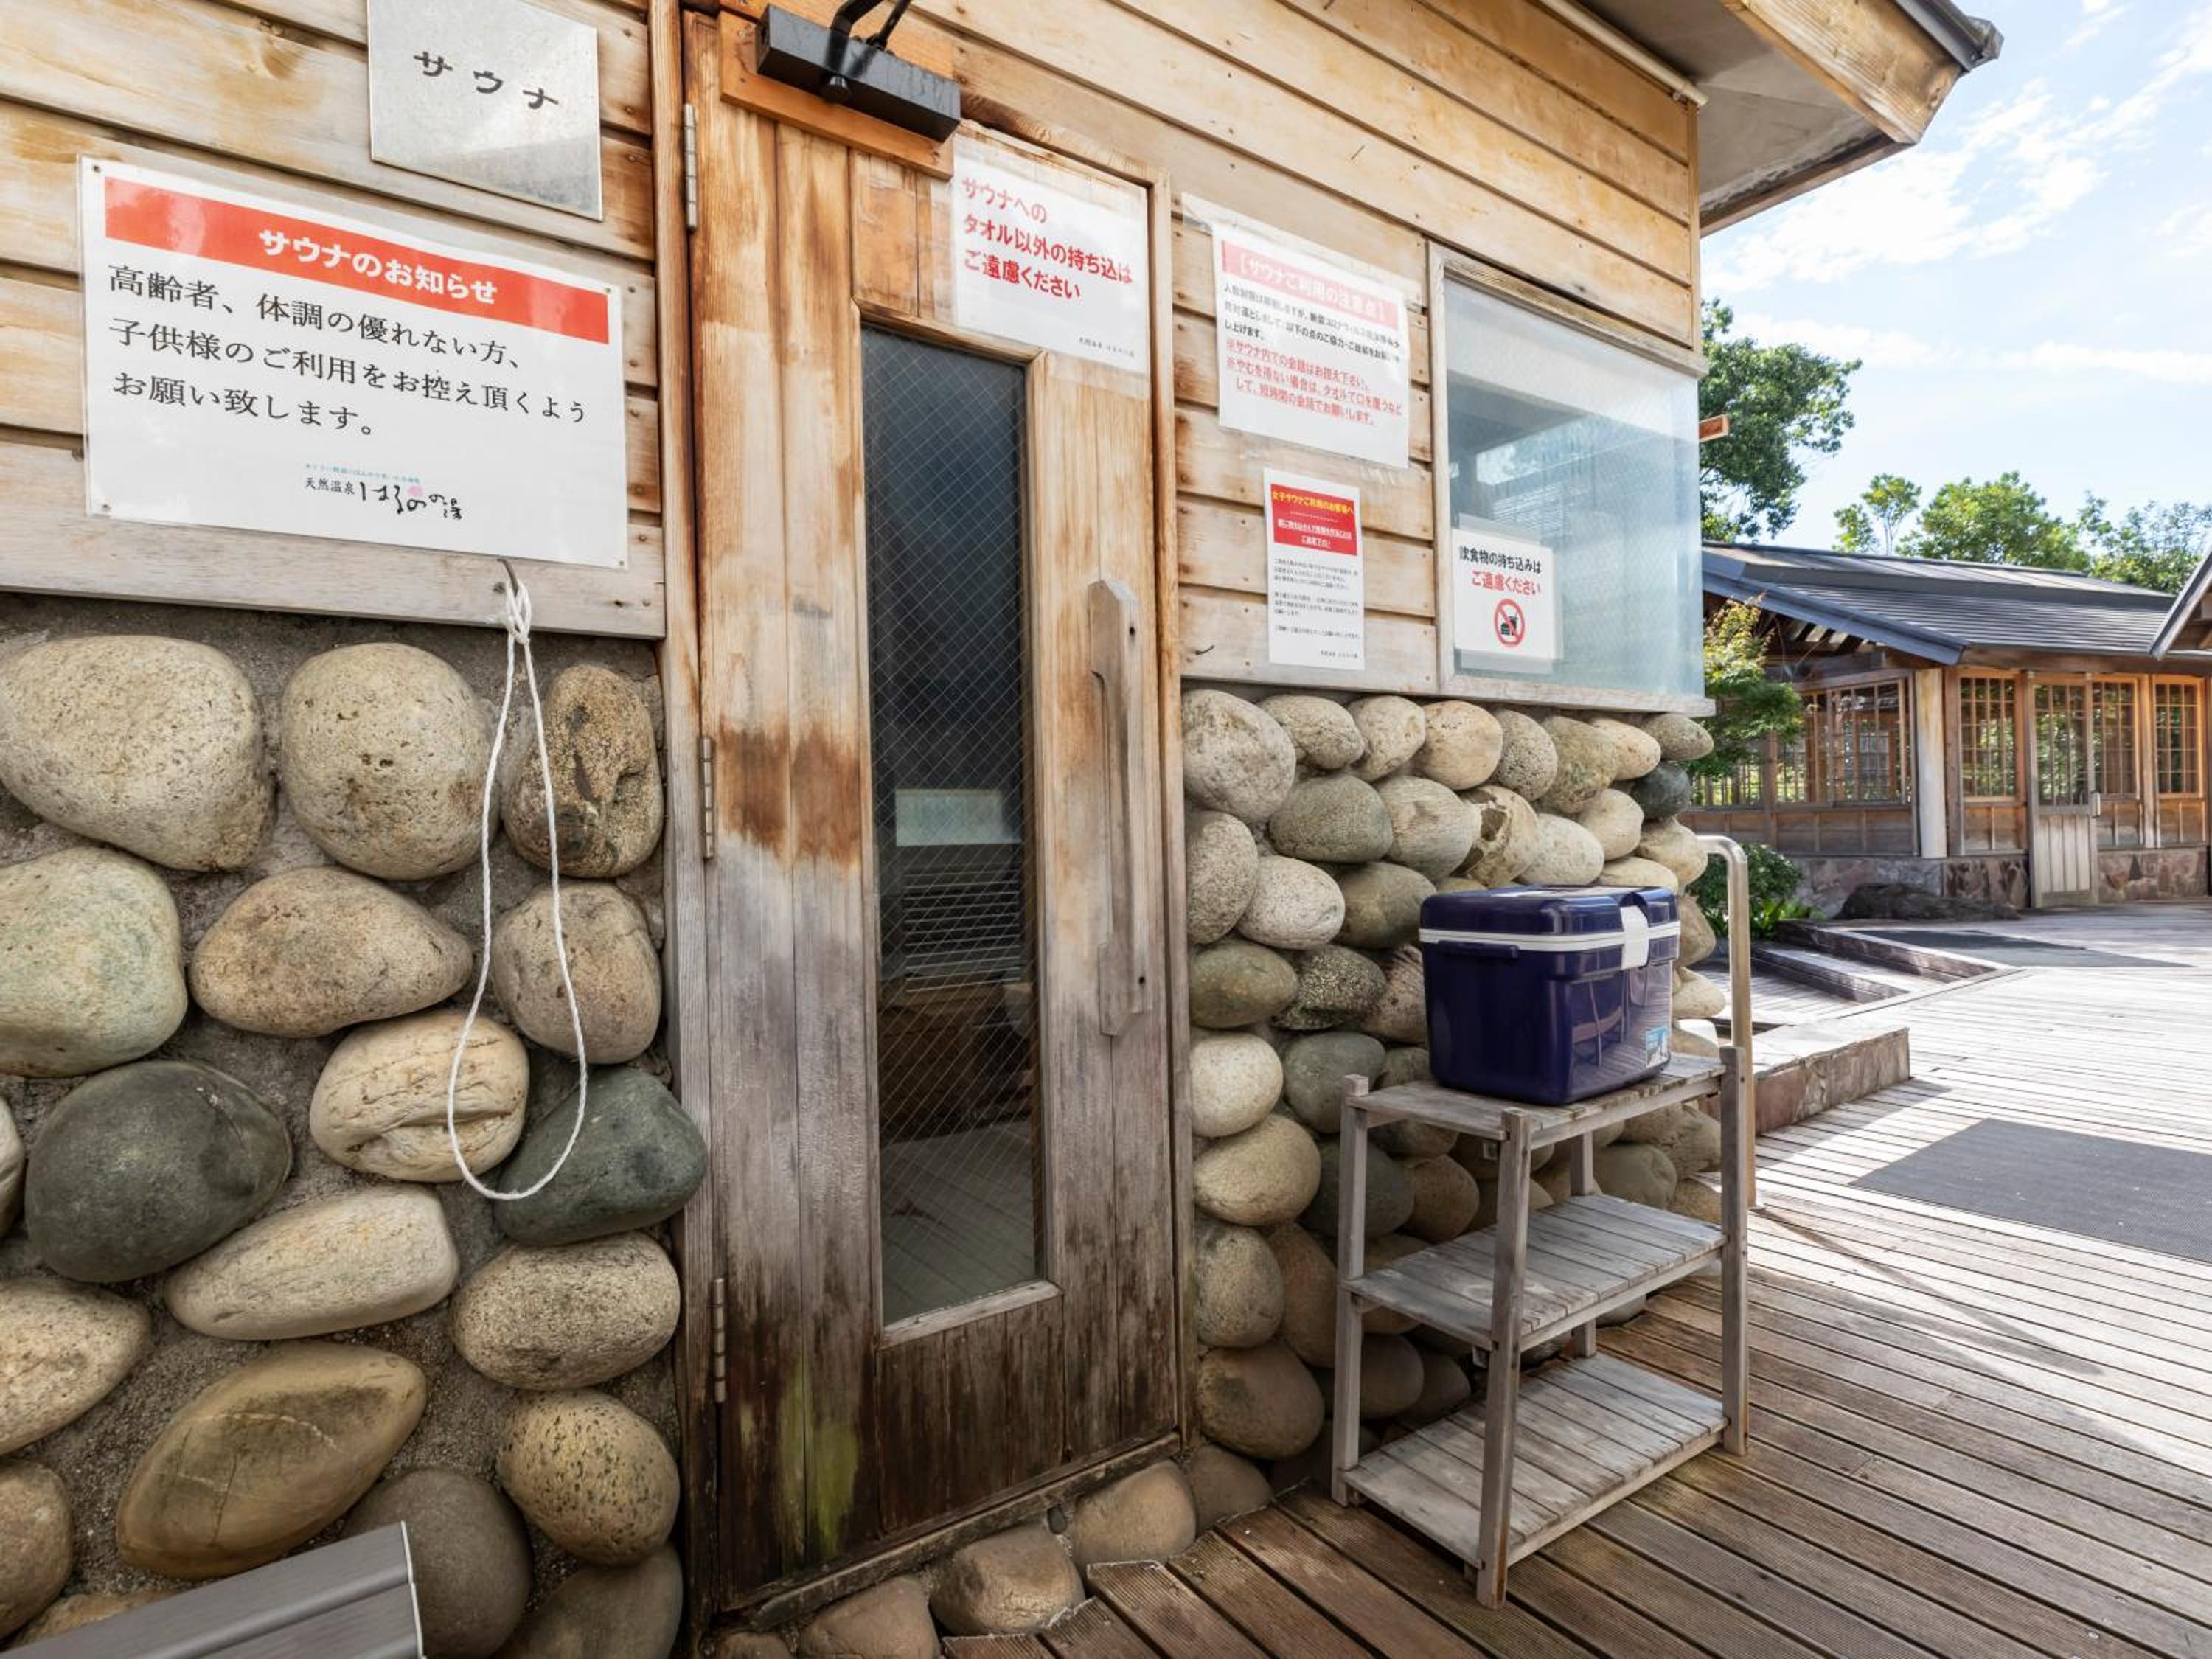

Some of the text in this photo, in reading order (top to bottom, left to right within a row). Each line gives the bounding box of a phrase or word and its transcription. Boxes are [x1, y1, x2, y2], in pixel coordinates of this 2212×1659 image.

[413, 51, 559, 111] サウナ
[962, 177, 1047, 223] サウナへの
[259, 229, 498, 305] サウナのお知らせ
[964, 249, 1080, 299] ご遠慮ください
[965, 214, 1133, 284] タオル以外の持ち込は
[108, 265, 518, 369] 高齢者、体調の優れない方、
[109, 317, 585, 422] 子供様のご利用をお控え頂くよう
[113, 372, 372, 436] お願い致します。
